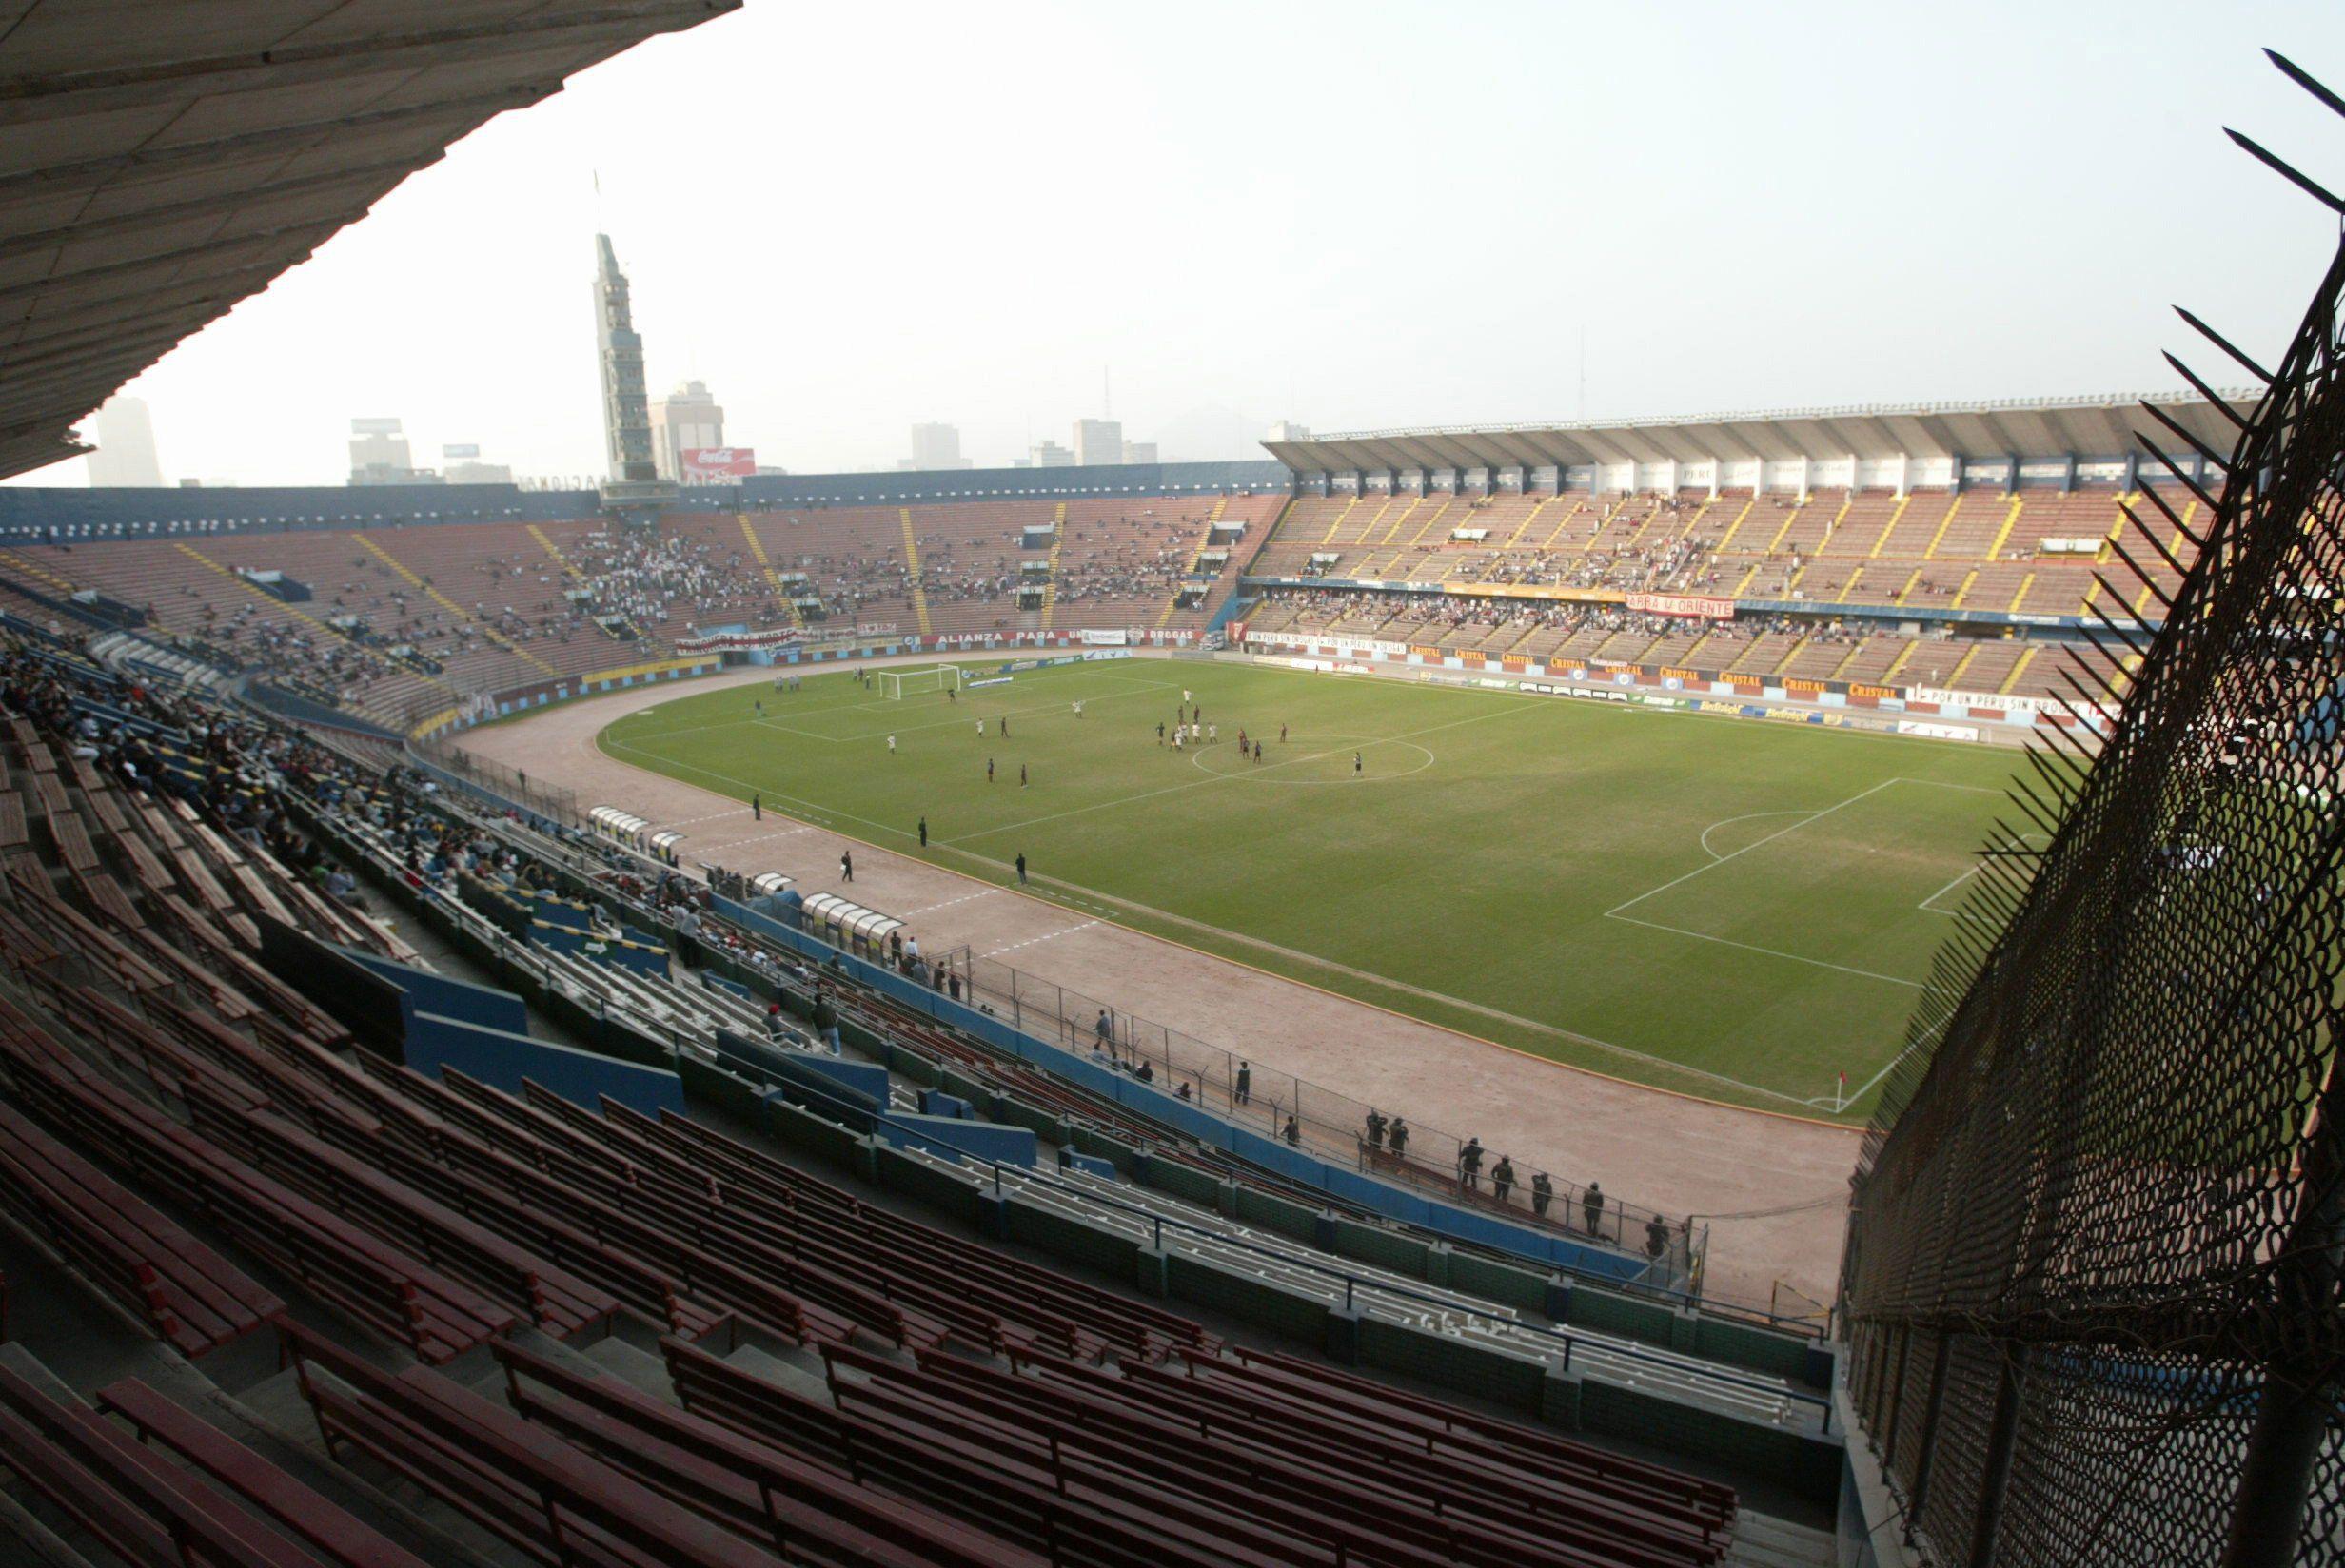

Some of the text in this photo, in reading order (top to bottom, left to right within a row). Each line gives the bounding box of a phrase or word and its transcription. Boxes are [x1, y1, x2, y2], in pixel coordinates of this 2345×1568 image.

[1678, 599, 1732, 615] ORIENTE
[759, 629, 793, 648] NORTE
[938, 632, 1003, 643] ALIANZA
[1016, 631, 1055, 640] PARA
[1150, 630, 1193, 639] DROGAS
[1409, 645, 1441, 657] CRISTAL
[1455, 648, 1487, 661] CRISTAL
[1502, 652, 1535, 665] CRISTAL
[1550, 657, 1586, 670] CRISTAL
[1660, 666, 1700, 681] CRISTAL
[1719, 671, 1761, 687] CRISTAL
[1782, 676, 1827, 693] CRISTAL
[1848, 683, 1897, 699] CRISTAL
[1932, 691, 1952, 703] POR
[1958, 693, 1972, 705] UN
[1977, 695, 2006, 708] PERU
[2011, 698, 2028, 710] SIN
